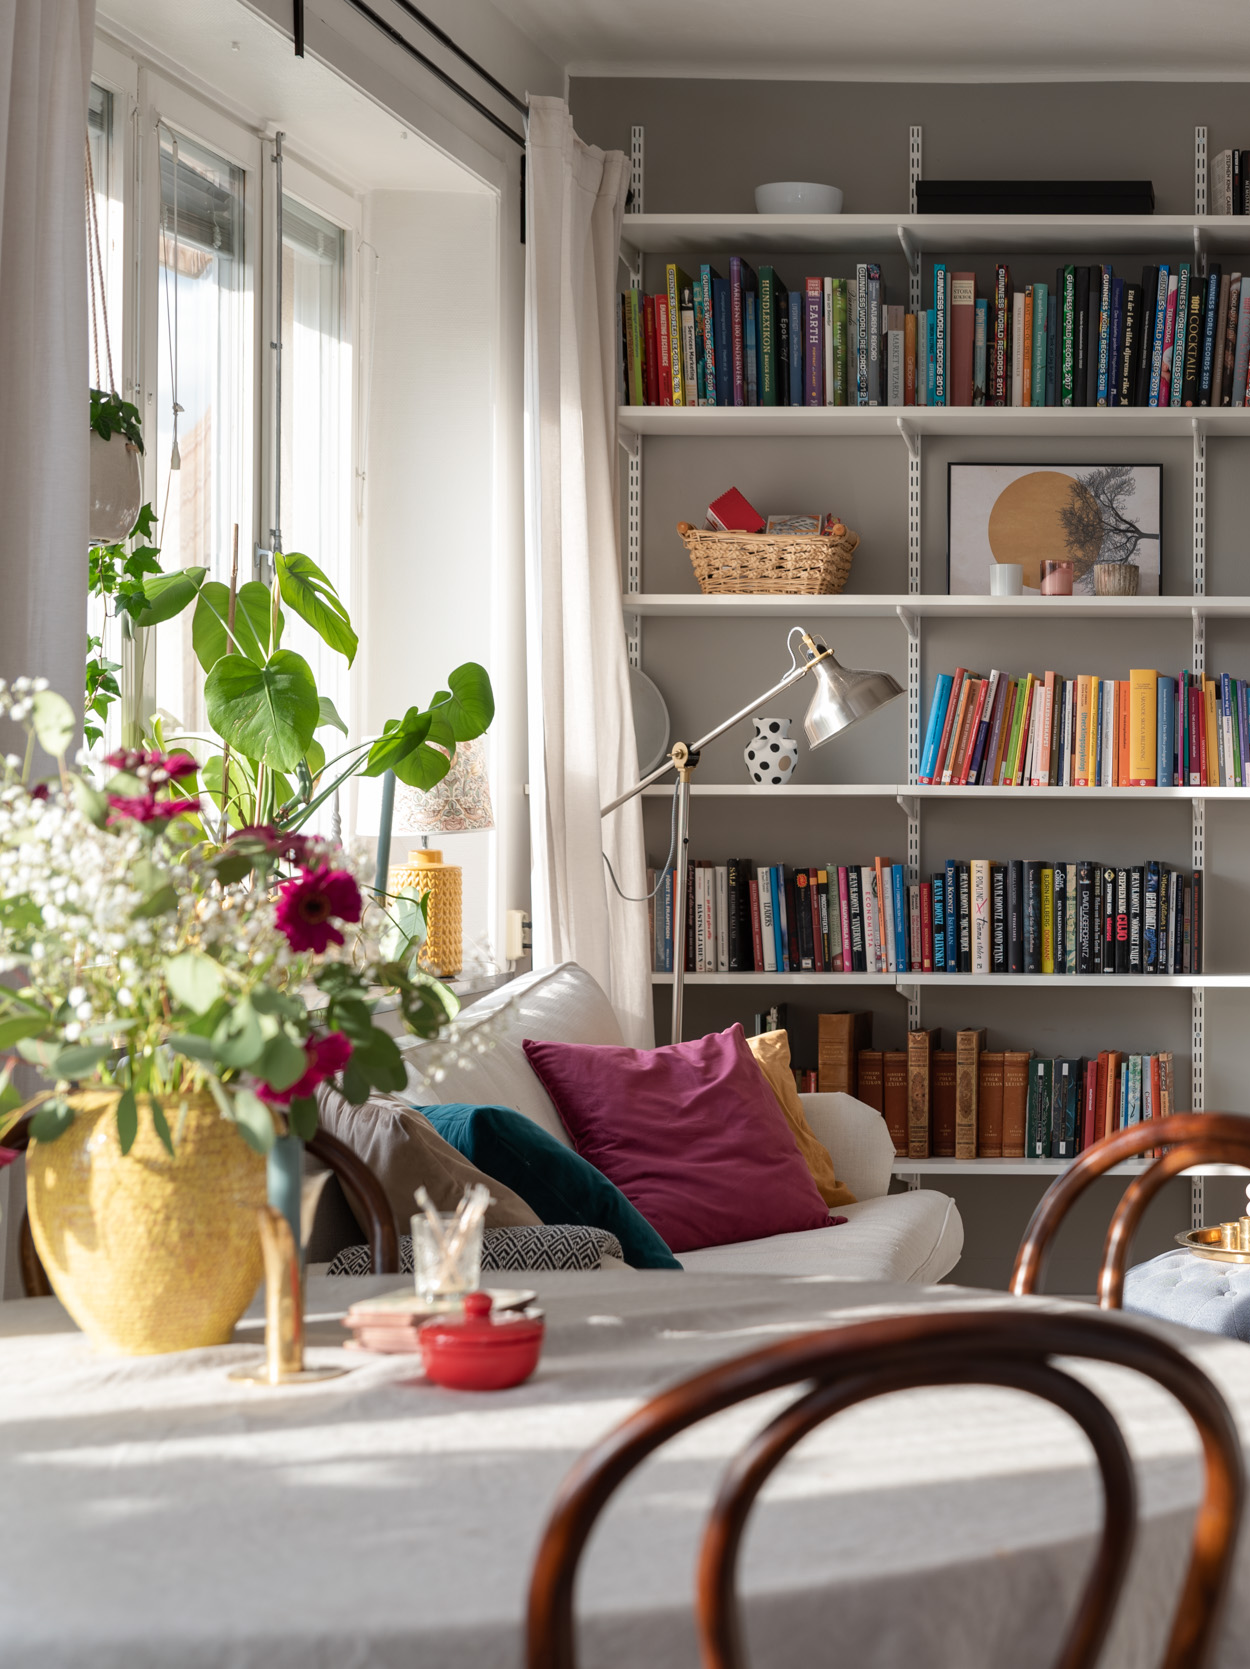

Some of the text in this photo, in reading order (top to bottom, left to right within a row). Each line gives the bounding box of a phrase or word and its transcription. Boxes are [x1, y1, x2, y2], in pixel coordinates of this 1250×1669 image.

[702, 274, 710, 311] GUINNESS
[936, 270, 944, 309] GUINNESS
[1158, 270, 1166, 310] GUINNESS
[1179, 269, 1187, 309] GUINNESS
[1208, 274, 1216, 309] GUINNESS
[762, 280, 771, 352] HUNDLEXIKON
[870, 301, 878, 334] NATURENS
[1127, 317, 1133, 327] de
[1128, 302, 1134, 311] år
[810, 305, 818, 343] EARTH
[1156, 312, 1164, 339] WORLD
[1177, 311, 1185, 338] WORLD
[1186, 295, 1200, 381] 1001 COCKTAILS
[661, 336, 669, 366] EXCELLENCE
[705, 340, 713, 373] RECORDS
[1122, 348, 1132, 376] djurens
[1153, 340, 1161, 377] RECORDS
[1174, 340, 1182, 377] RECORDS
[1204, 337, 1212, 370] RECORDS
[892, 366, 900, 399] WIZARDS
[1122, 378, 1130, 394] rike
[1079, 712, 1088, 771] Utvecklingspsykologi
[764, 902, 772, 927] LEADERS
[865, 892, 873, 947] ECONOMISTA
[1117, 871, 1128, 941] STEPHEN KING CUJO
[1146, 893, 1156, 930] DEAN KOONTZ
[976, 917, 988, 940] tomma
[976, 942, 984, 959] stolen
